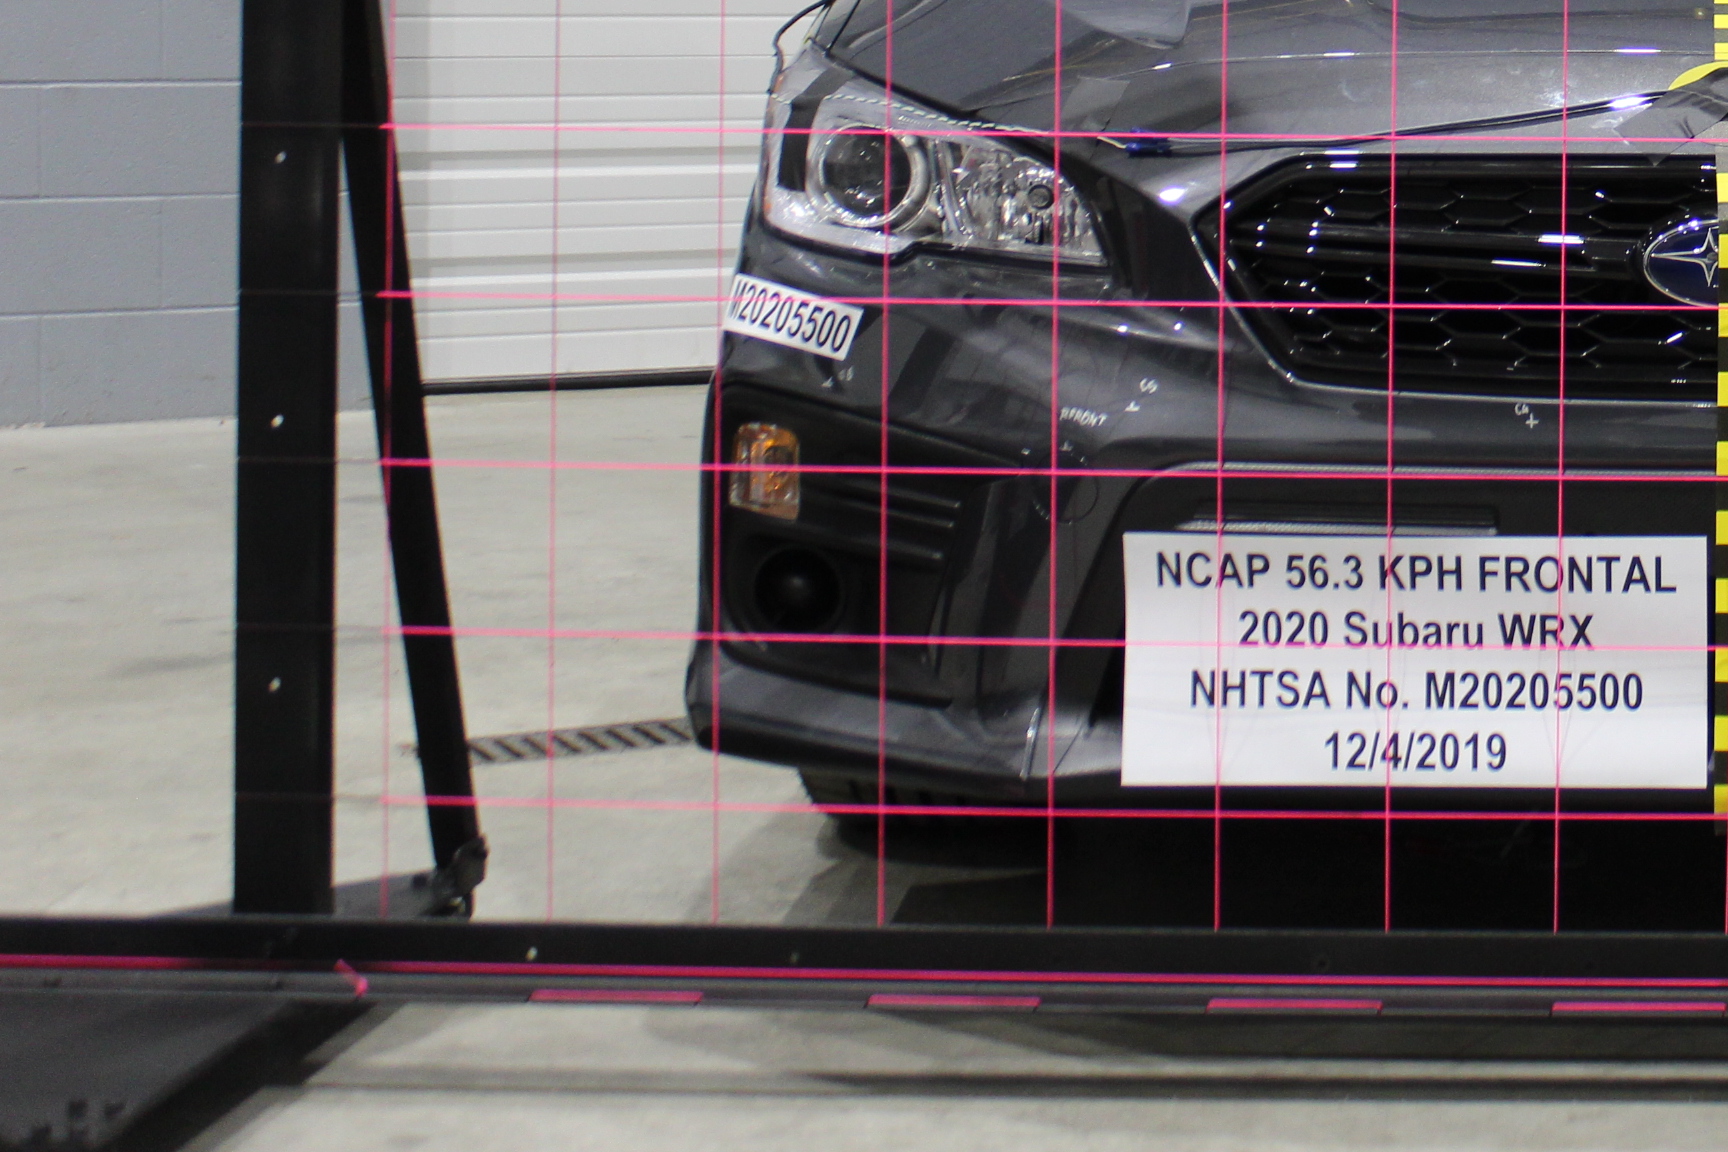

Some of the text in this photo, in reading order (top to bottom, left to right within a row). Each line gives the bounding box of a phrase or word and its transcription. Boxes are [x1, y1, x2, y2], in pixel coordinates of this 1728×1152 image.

[1156, 552, 1678, 594] NCAP 56.3 KPH FRONTAL
[1238, 610, 1595, 651] 2020 Subaru WRX
[1190, 670, 1643, 711] NHTSA No. M20205500
[1324, 732, 1508, 772] 12/4/2019
